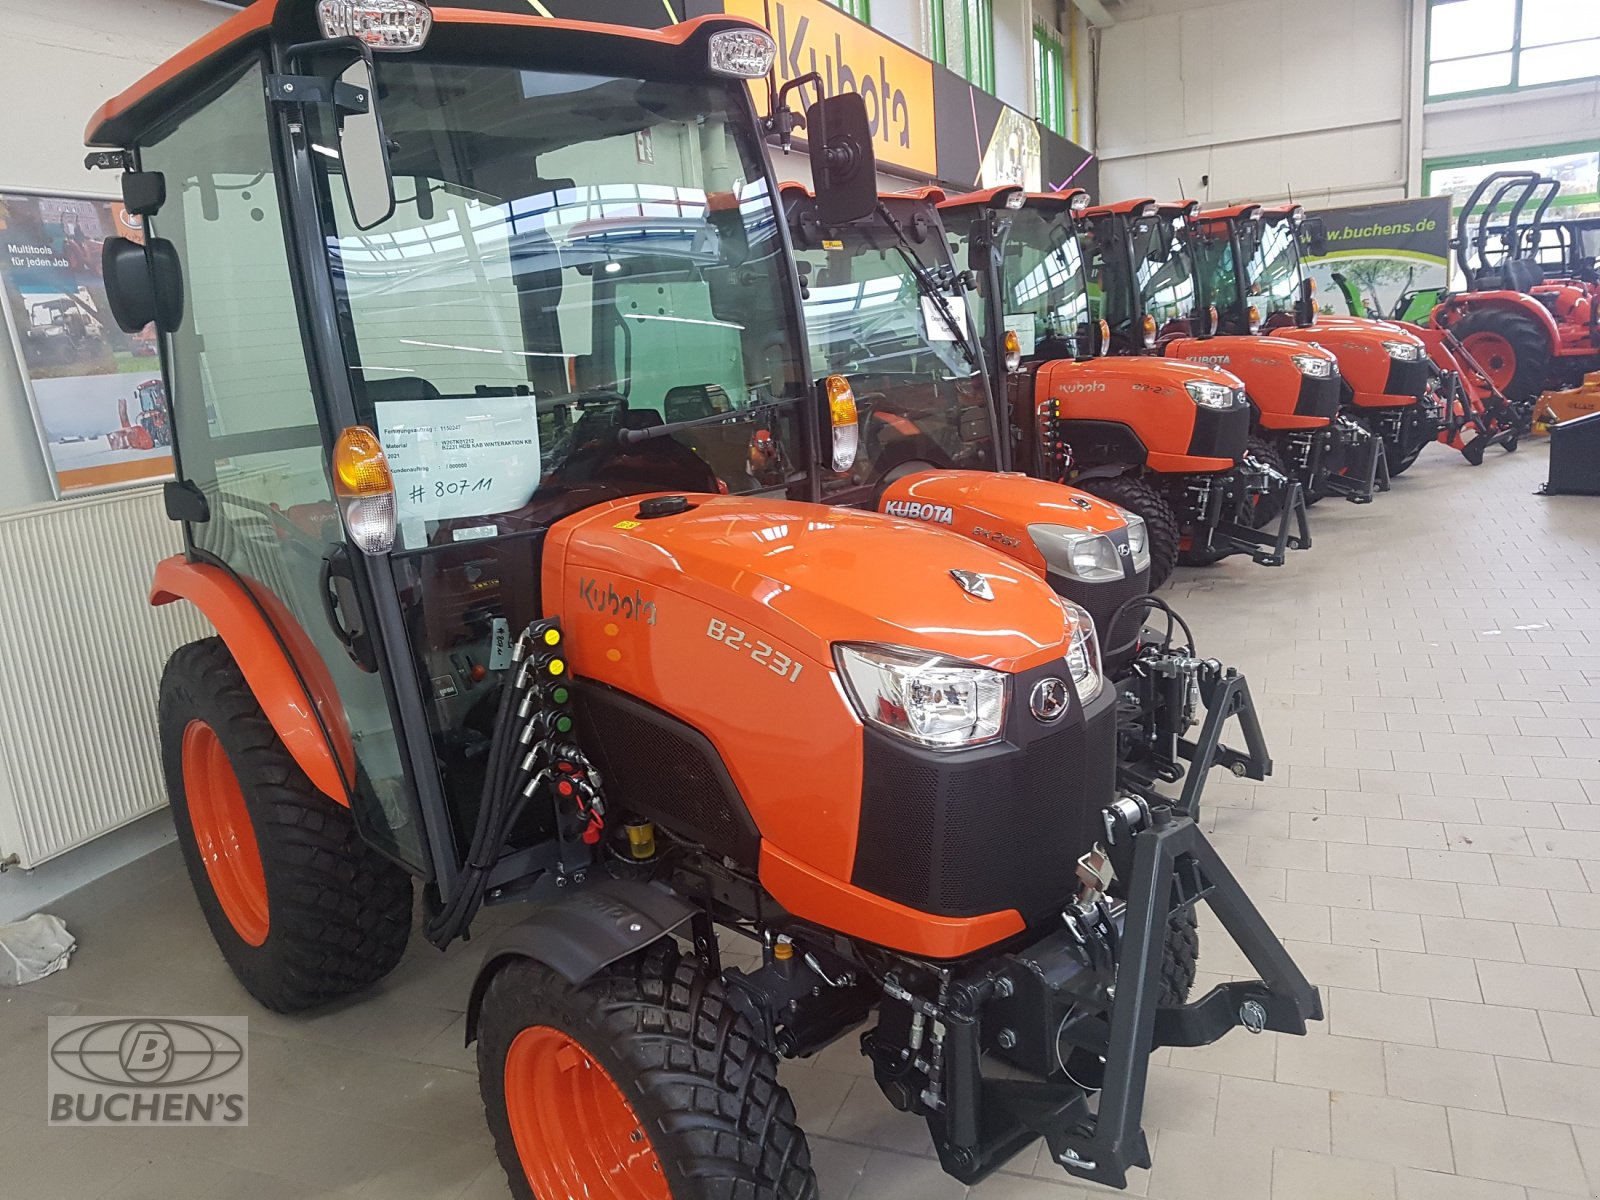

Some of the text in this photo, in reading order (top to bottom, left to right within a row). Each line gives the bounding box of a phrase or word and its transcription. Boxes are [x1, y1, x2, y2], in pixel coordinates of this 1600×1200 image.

[7, 243, 53, 255] Multitools
[11, 256, 69, 268] für jeden Job
[1059, 380, 1106, 393] Kubota
[483, 439, 524, 447] WINTERAKTION
[435, 477, 493, 498] 80711
[885, 500, 953, 525] KUBOTA
[579, 577, 657, 626] Kubota
[706, 617, 804, 683] B2-231
